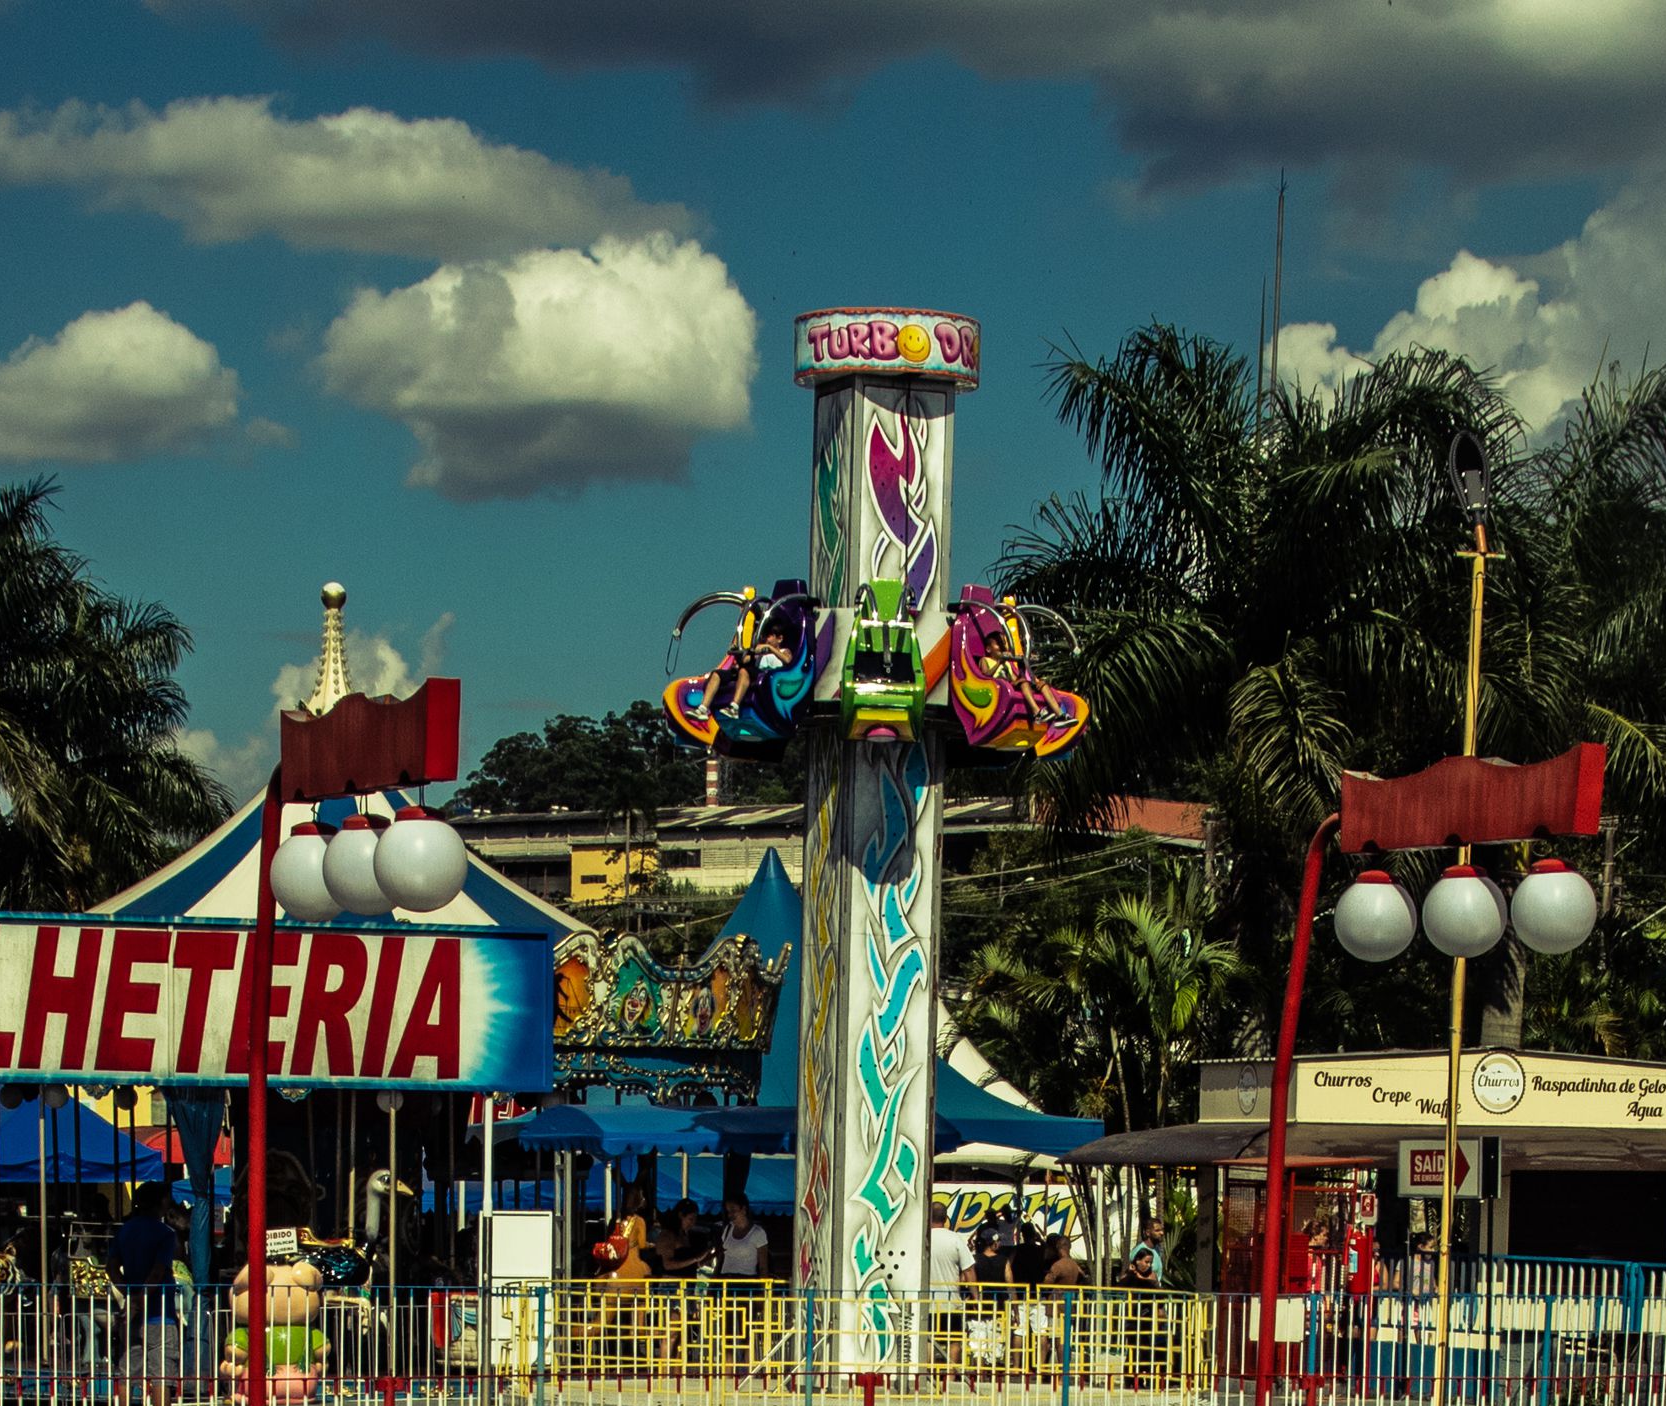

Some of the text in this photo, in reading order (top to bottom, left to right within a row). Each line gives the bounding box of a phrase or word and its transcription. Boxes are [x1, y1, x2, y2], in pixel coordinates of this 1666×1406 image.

[1313, 1070, 1373, 1088] Churros
[1477, 1074, 1520, 1088] Churros
[1531, 1075, 1618, 1097] Raspadinha
[1618, 1080, 1636, 1094] de
[1371, 1086, 1413, 1107] Crepe
[1625, 1096, 1664, 1121] Água
[1414, 1151, 1445, 1172] SAÍD
